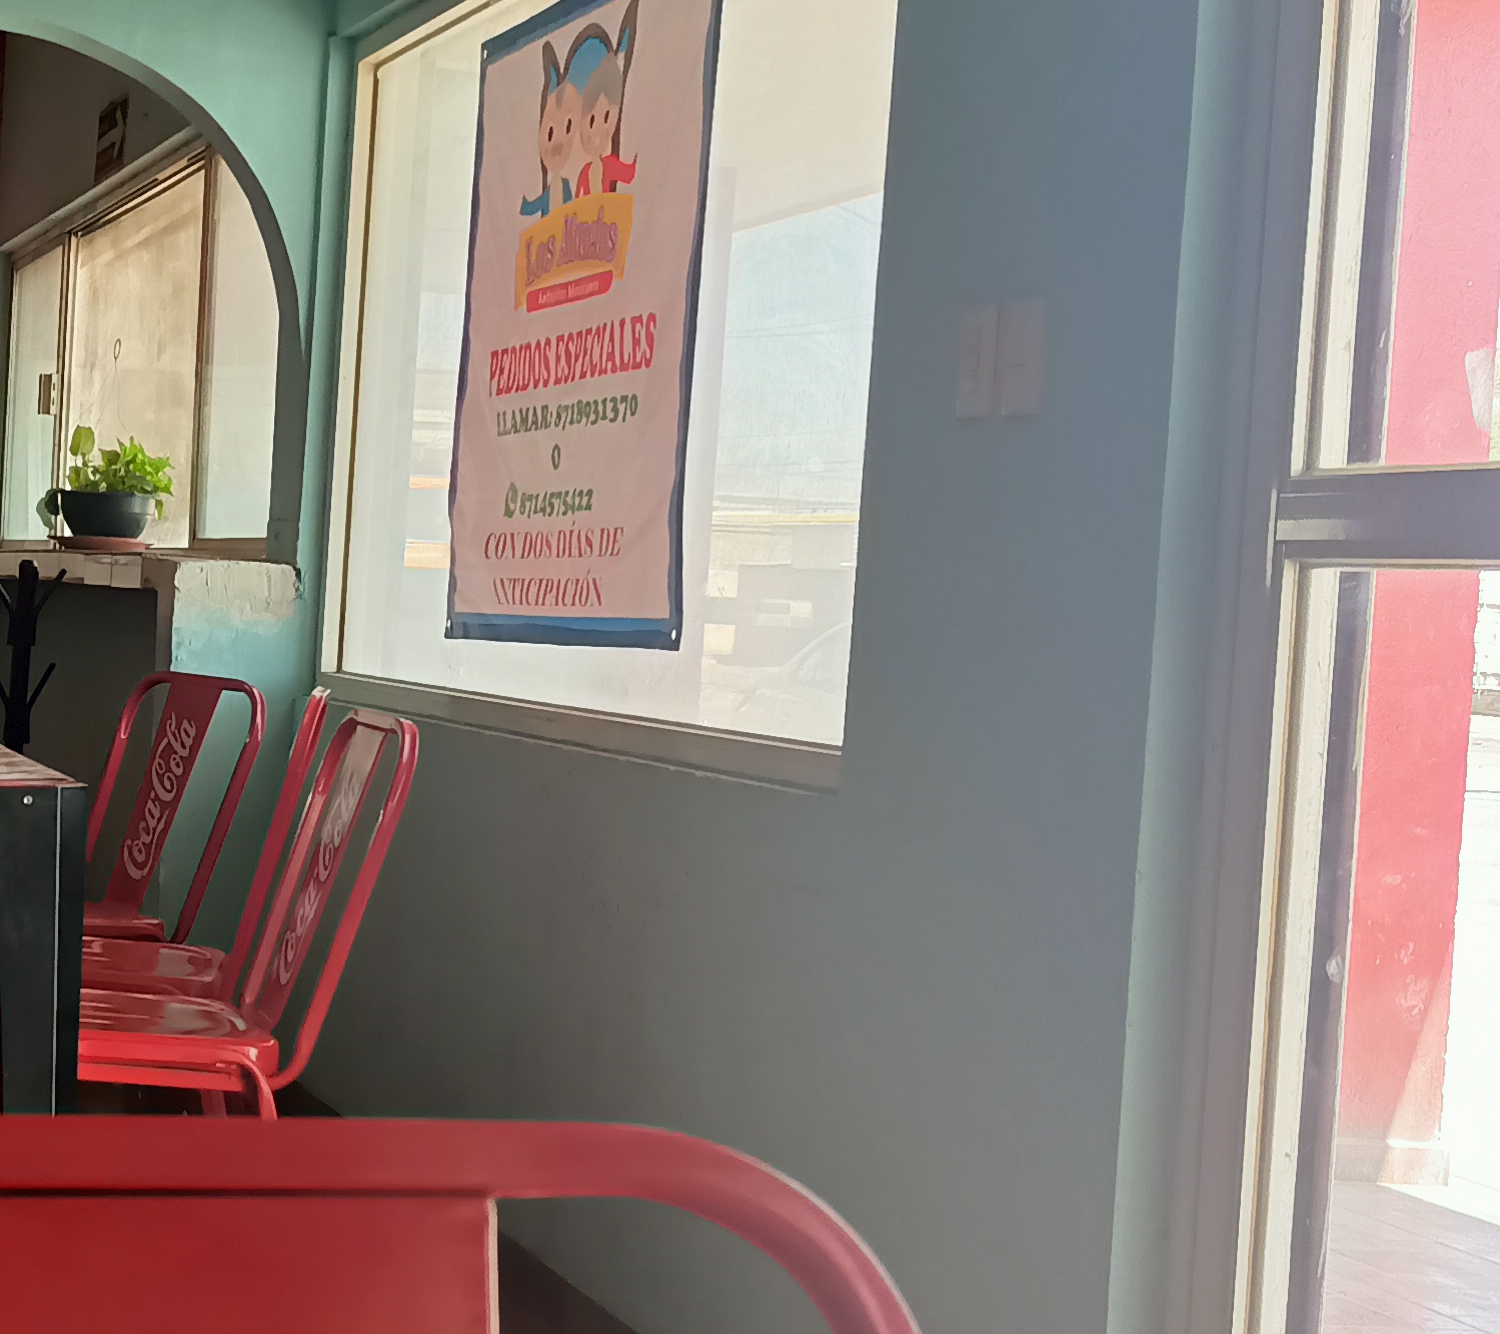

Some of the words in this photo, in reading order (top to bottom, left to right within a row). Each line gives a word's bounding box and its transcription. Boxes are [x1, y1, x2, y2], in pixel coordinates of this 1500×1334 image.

[489, 335, 551, 398] PEDIDOS
[554, 312, 657, 386] ESPECIALES
[484, 528, 520, 560] CON
[520, 527, 552, 560] DOS
[556, 520, 595, 559] DÍAS
[598, 526, 624, 558] DE
[123, 711, 200, 880] Coca-Cola
